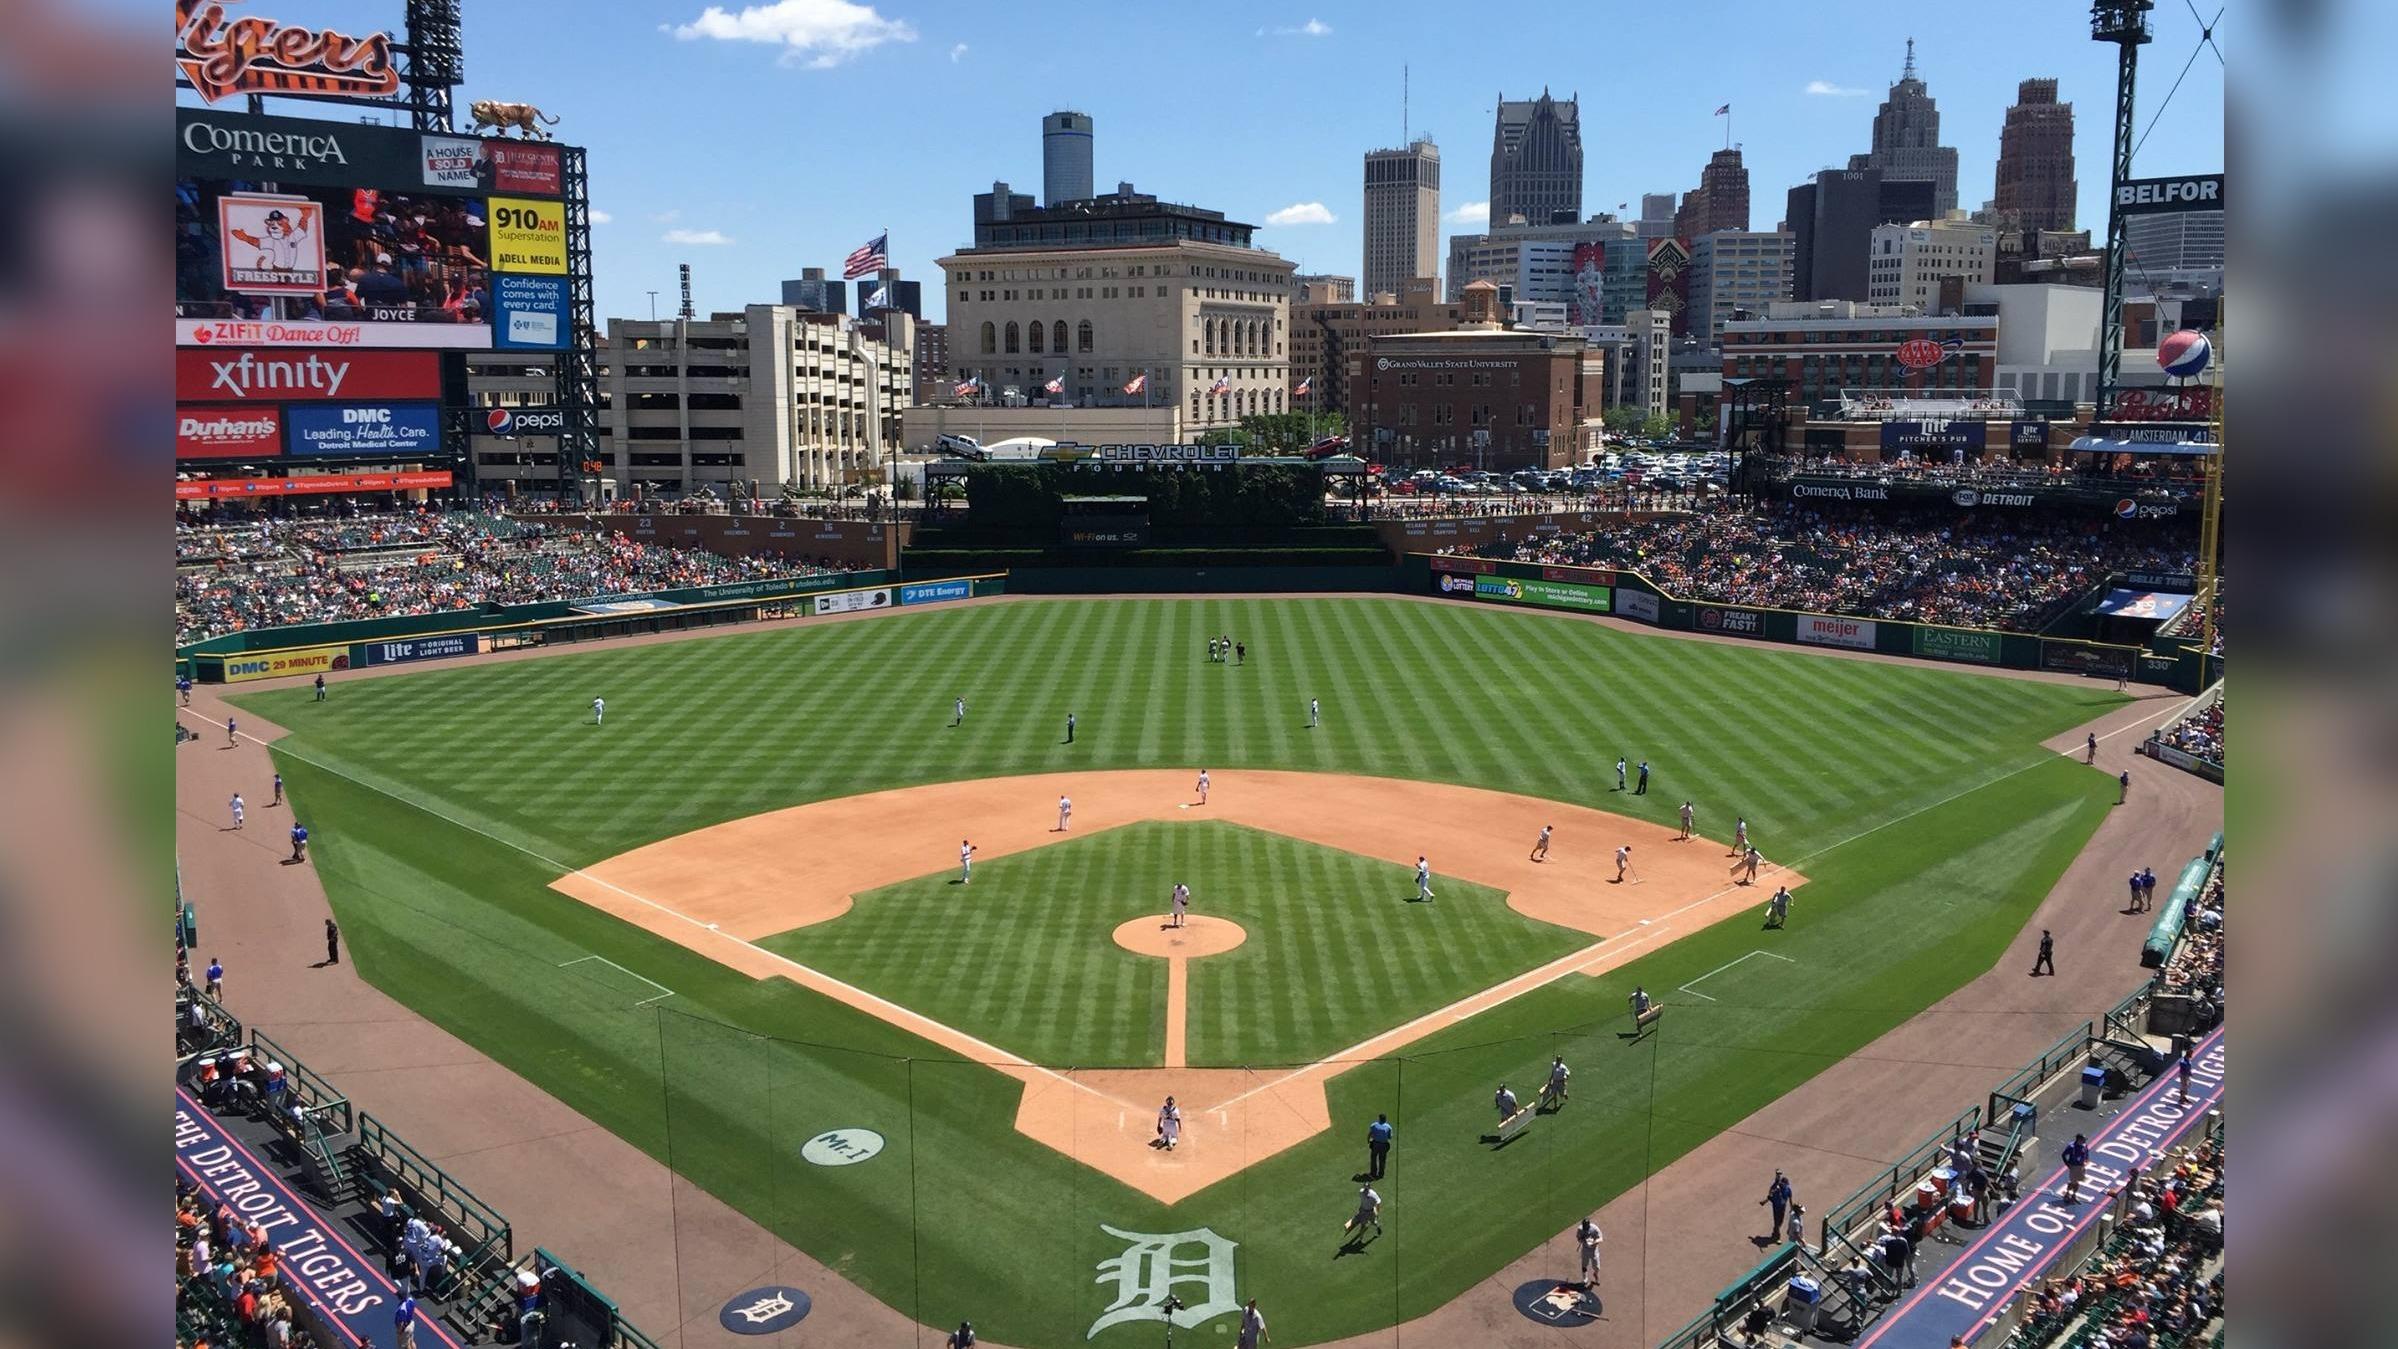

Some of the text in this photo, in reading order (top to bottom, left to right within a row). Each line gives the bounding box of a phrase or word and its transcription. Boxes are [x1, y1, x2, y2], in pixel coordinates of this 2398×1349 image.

[427, 147, 473, 159] A HOUSE
[232, 153, 307, 170] PARK
[435, 159, 467, 170] SOLD
[437, 170, 470, 181] NAME
[1843, 172, 1864, 181] 1001
[2119, 181, 2219, 205] BELFOR
[498, 230, 560, 243] Superstation
[499, 254, 560, 266] ADELL MEDIA
[502, 278, 558, 290] Confidence
[503, 290, 559, 300] comes with
[503, 301, 530, 311] every
[373, 309, 415, 321] JOYCE
[267, 326, 323, 342] Dance
[327, 326, 360, 344] Off!
[1389, 360, 1518, 369] GRAND VALLEY STATE UNIVERSITY
[210, 353, 350, 397] xfinity
[343, 409, 391, 423] DMC
[515, 412, 563, 430] pepsi
[179, 417, 276, 436] Dunham's
[1921, 418, 1950, 436] Lite
[304, 428, 355, 441] Leading.
[400, 426, 430, 438] Care.
[1899, 435, 1968, 443] PITCHER'S PUB
[2110, 428, 2129, 439] NEW
[2129, 429, 2188, 442] AMSTERDAM
[319, 440, 418, 449] Detroit Medical Center
[1100, 444, 1245, 461] CHEVROLET
[1074, 465, 1222, 473] FOUNTAIN
[1855, 486, 1888, 500] Bank
[1958, 492, 2034, 506] FOX DETROIT
[2140, 504, 2177, 518] pepsi
[639, 518, 651, 528] 23
[1580, 514, 1592, 523] 42
[1073, 532, 1096, 541] Wi-Fi
[1453, 583, 1474, 591] LOTTERY
[2129, 574, 2191, 587] BELLE TIRE
[704, 589, 718, 598] The
[719, 586, 754, 596] University
[765, 583, 788, 591] Toledo
[918, 587, 965, 598] DTE Energy
[1526, 585, 1537, 593] Play
[1724, 610, 1758, 621] FREAKY
[1722, 618, 1756, 631] FAST!
[1813, 618, 1860, 636] meijer
[1924, 628, 1991, 649] EASTERN
[382, 643, 412, 662] Lite
[427, 639, 464, 648] ORIGINAL
[420, 645, 464, 657] LIGHT BEER
[229, 660, 270, 676] DMC
[288, 655, 329, 669] MINUTE
[818, 1133, 853, 1154] Mr.
[189, 1144, 300, 1230] DETROIT
[277, 1228, 383, 1316] TIGERS
[1937, 1232, 2044, 1310] HOME
[2027, 1202, 2076, 1235] OF
